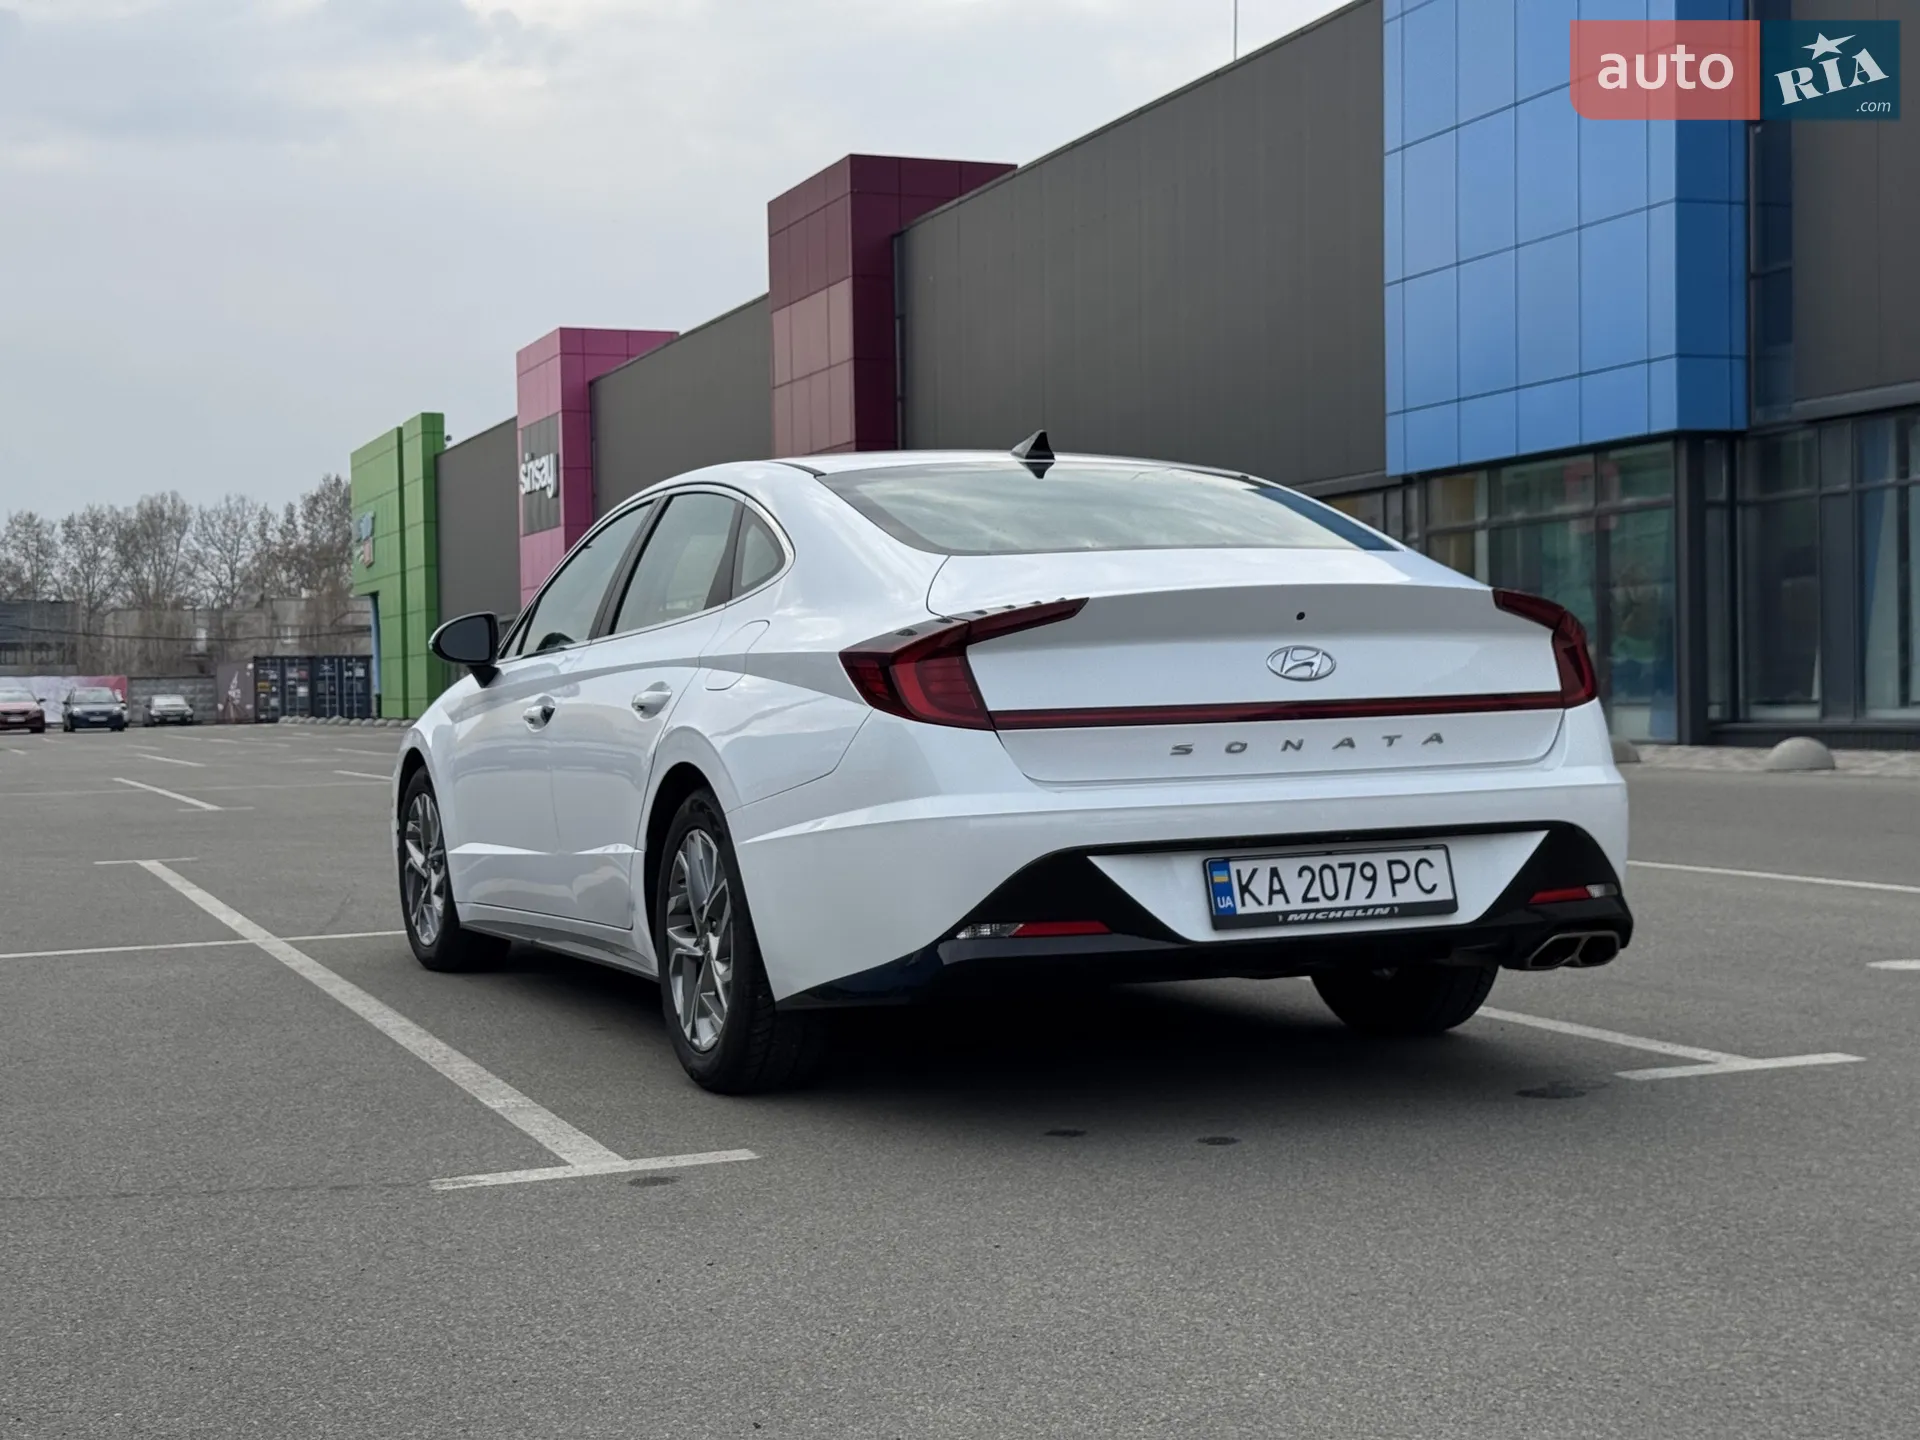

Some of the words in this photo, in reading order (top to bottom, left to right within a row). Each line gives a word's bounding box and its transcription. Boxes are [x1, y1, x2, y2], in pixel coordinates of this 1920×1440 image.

[519, 452, 555, 499] sinsay
[1169, 732, 1445, 756] SONATA
[1235, 866, 1291, 908] KA
[1297, 861, 1378, 904] 2079
[1386, 857, 1439, 898] PC
[1216, 894, 1235, 909] UA
[1286, 906, 1393, 922] MICHELIN
